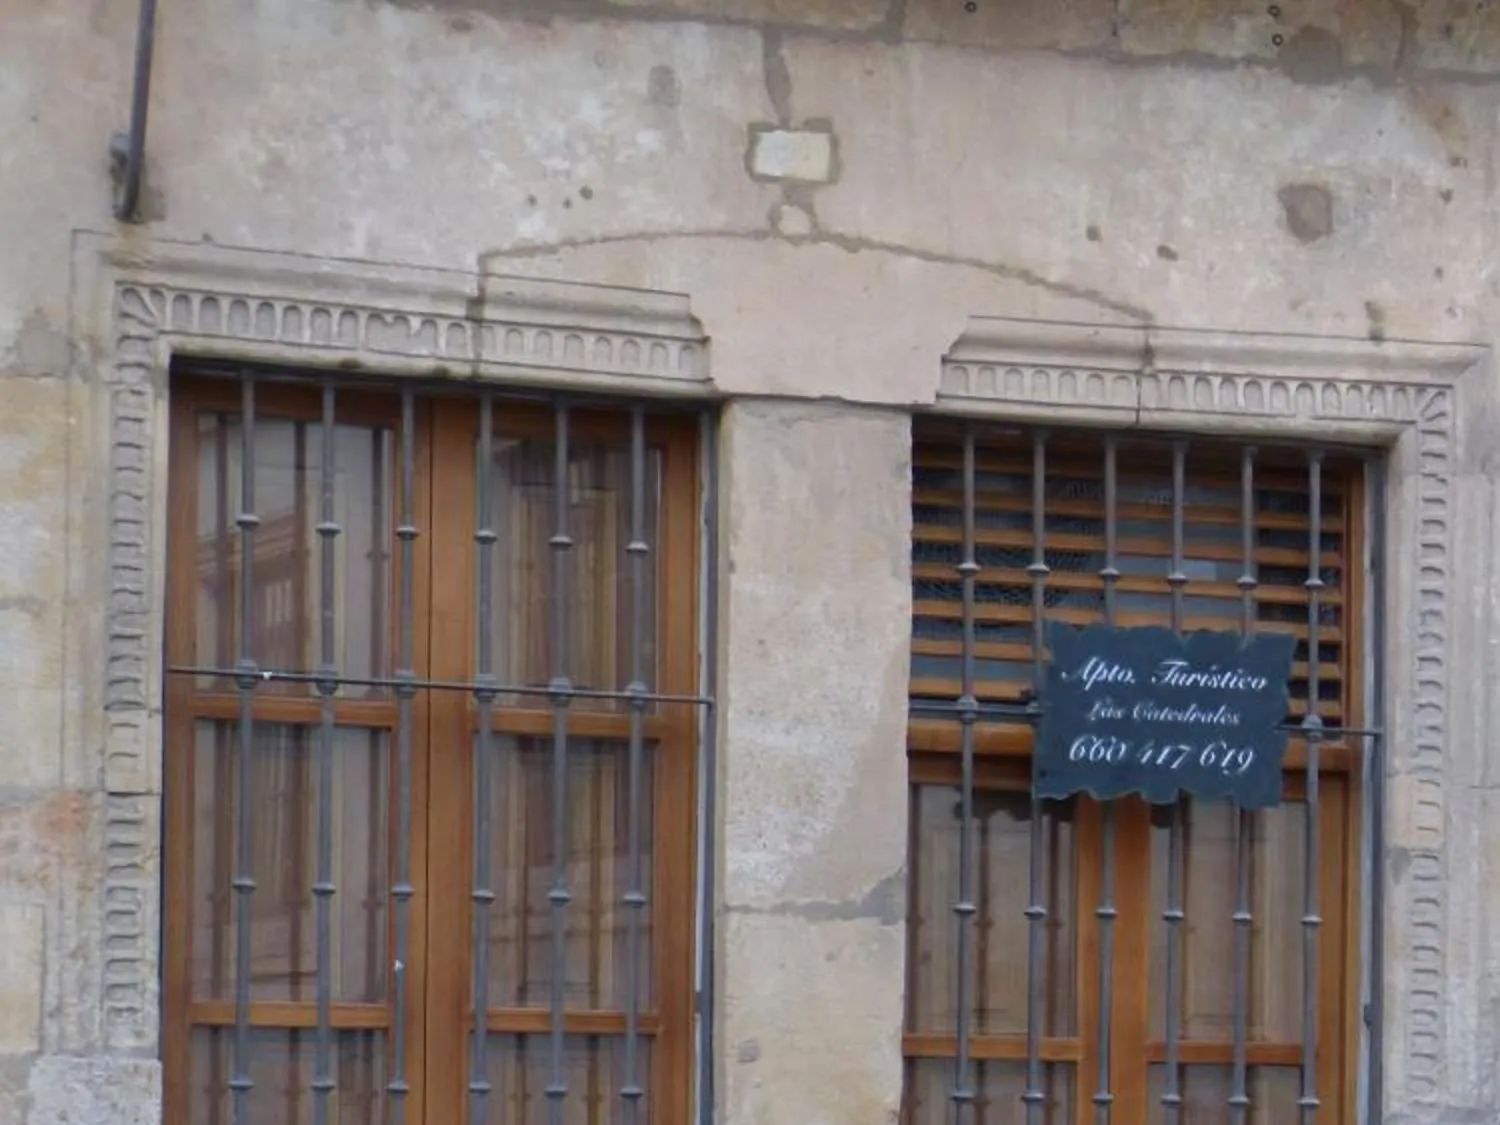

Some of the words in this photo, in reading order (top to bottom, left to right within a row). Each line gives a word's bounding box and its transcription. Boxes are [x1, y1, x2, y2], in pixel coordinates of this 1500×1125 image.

[1132, 701, 1240, 725] Catedrales
[1068, 733, 1128, 763] 660
[1137, 739, 1191, 769] 417
[1199, 740, 1254, 774] 619
